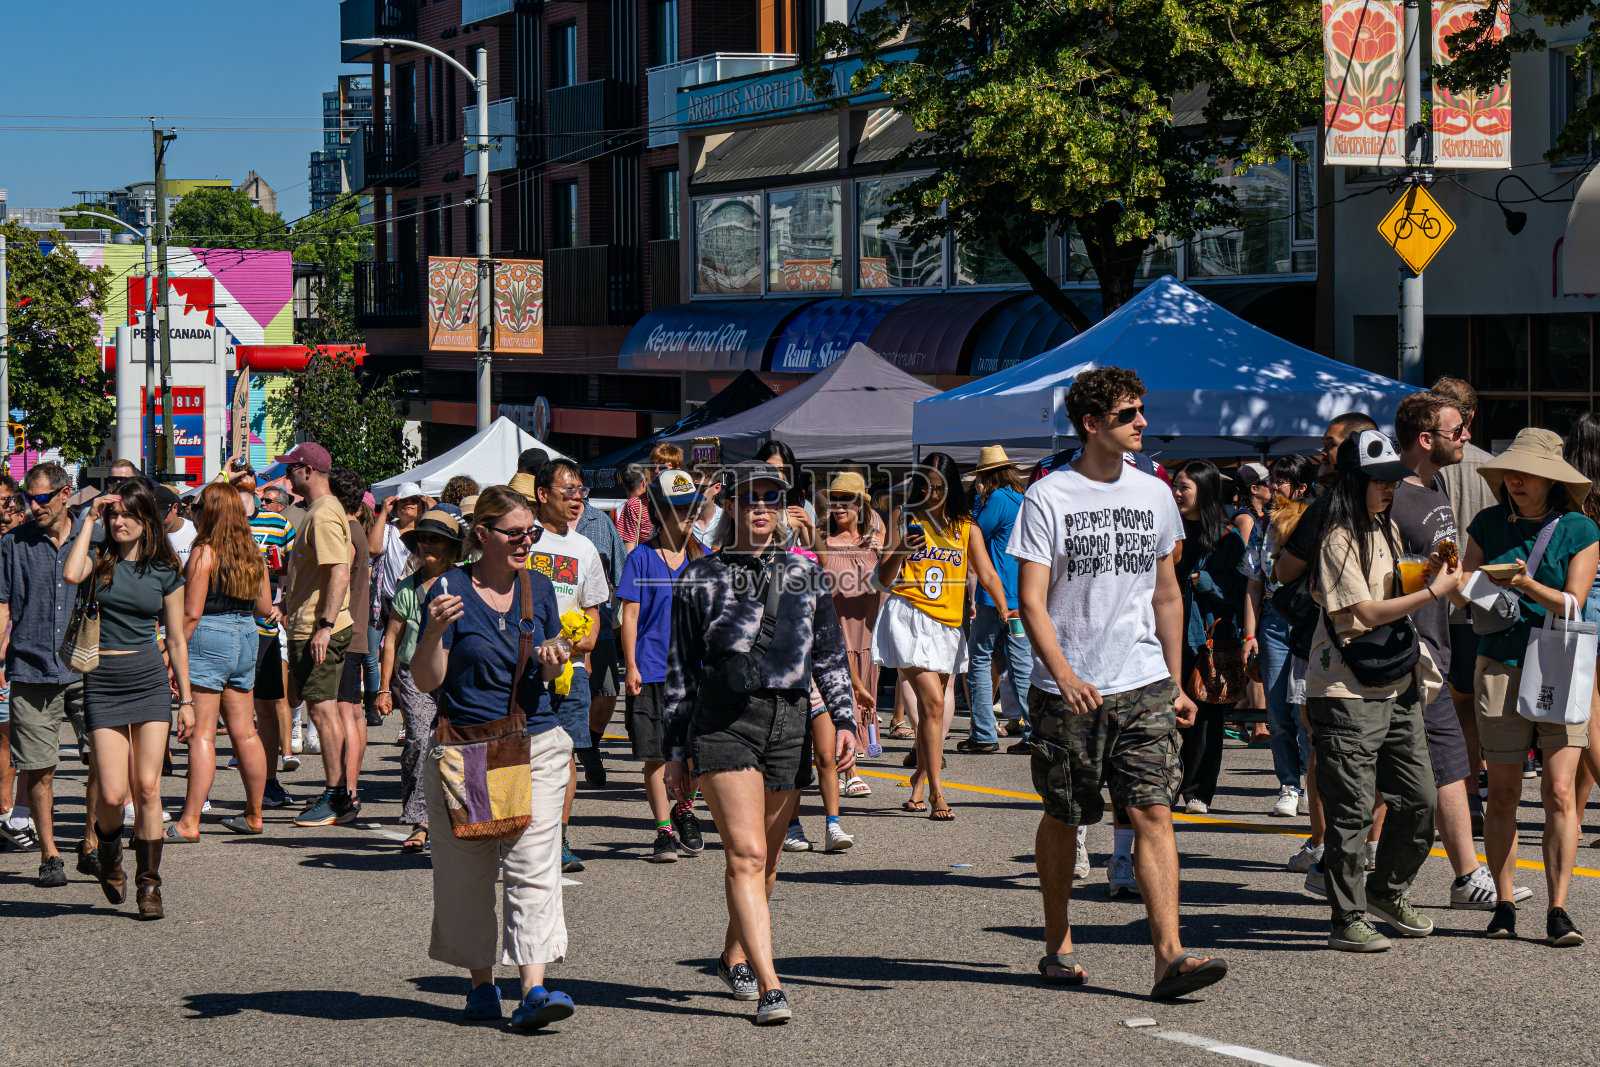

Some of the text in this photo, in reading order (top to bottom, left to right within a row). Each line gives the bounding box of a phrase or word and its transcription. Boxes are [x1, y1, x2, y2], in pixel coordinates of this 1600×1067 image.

[688, 70, 850, 122] ARBUTUS NORTH DEAL
[645, 323, 748, 359] Repair and Run
[782, 340, 812, 368] Rain
[1064, 507, 1154, 537] PEEPEE POOPOO
[1064, 532, 1157, 558] POOPOO PEEPEE
[1067, 552, 1155, 582] PEEPEE POOPOO
[923, 566, 944, 599] 8
